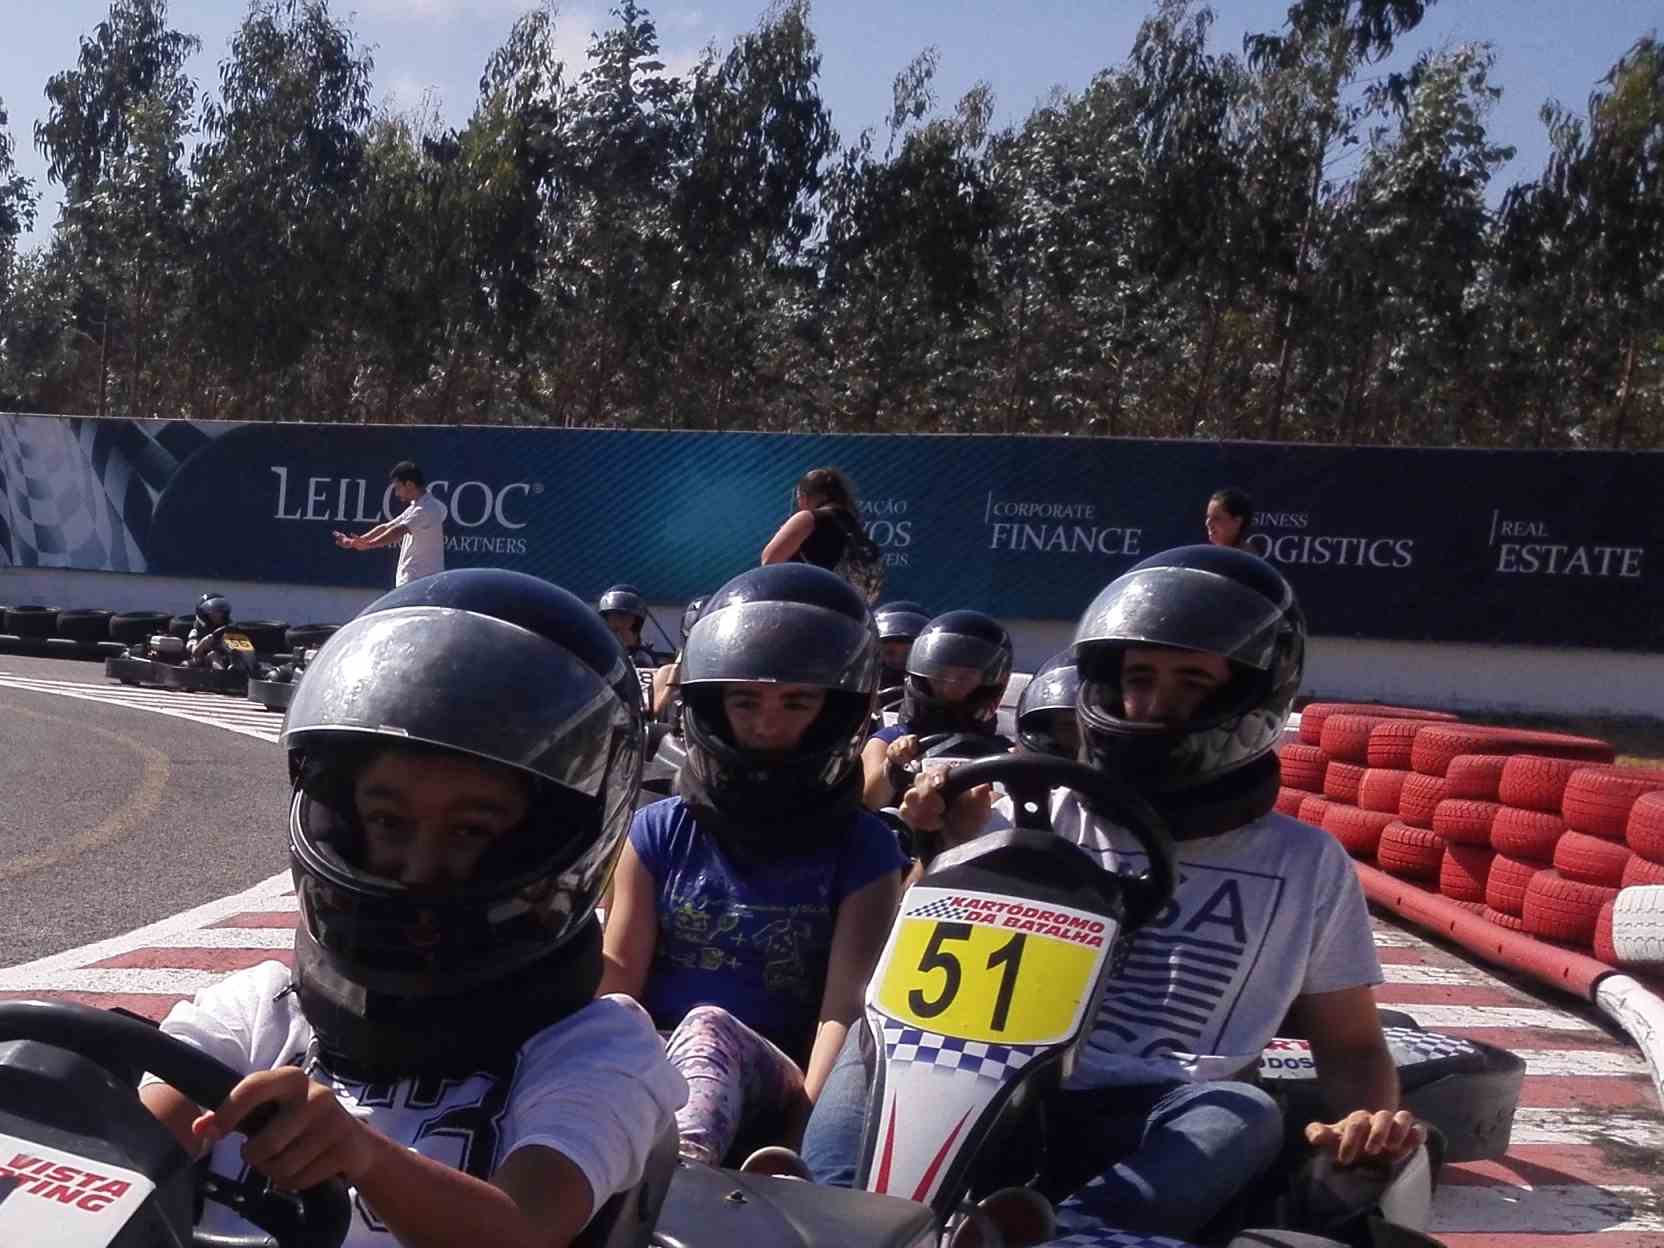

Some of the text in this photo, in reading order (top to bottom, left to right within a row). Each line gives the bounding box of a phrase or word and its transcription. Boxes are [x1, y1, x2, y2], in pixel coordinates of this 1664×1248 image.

[993, 502, 1096, 519] CORPORATE
[989, 523, 1142, 555] FINANCE
[1500, 520, 1550, 537] REAL
[1244, 533, 1414, 568] OGISTICS
[1496, 543, 1644, 577] ESTATE
[964, 911, 1105, 947] DA BATALHA
[908, 922, 1027, 1032] 51
[7, 1153, 133, 1199] VISTA
